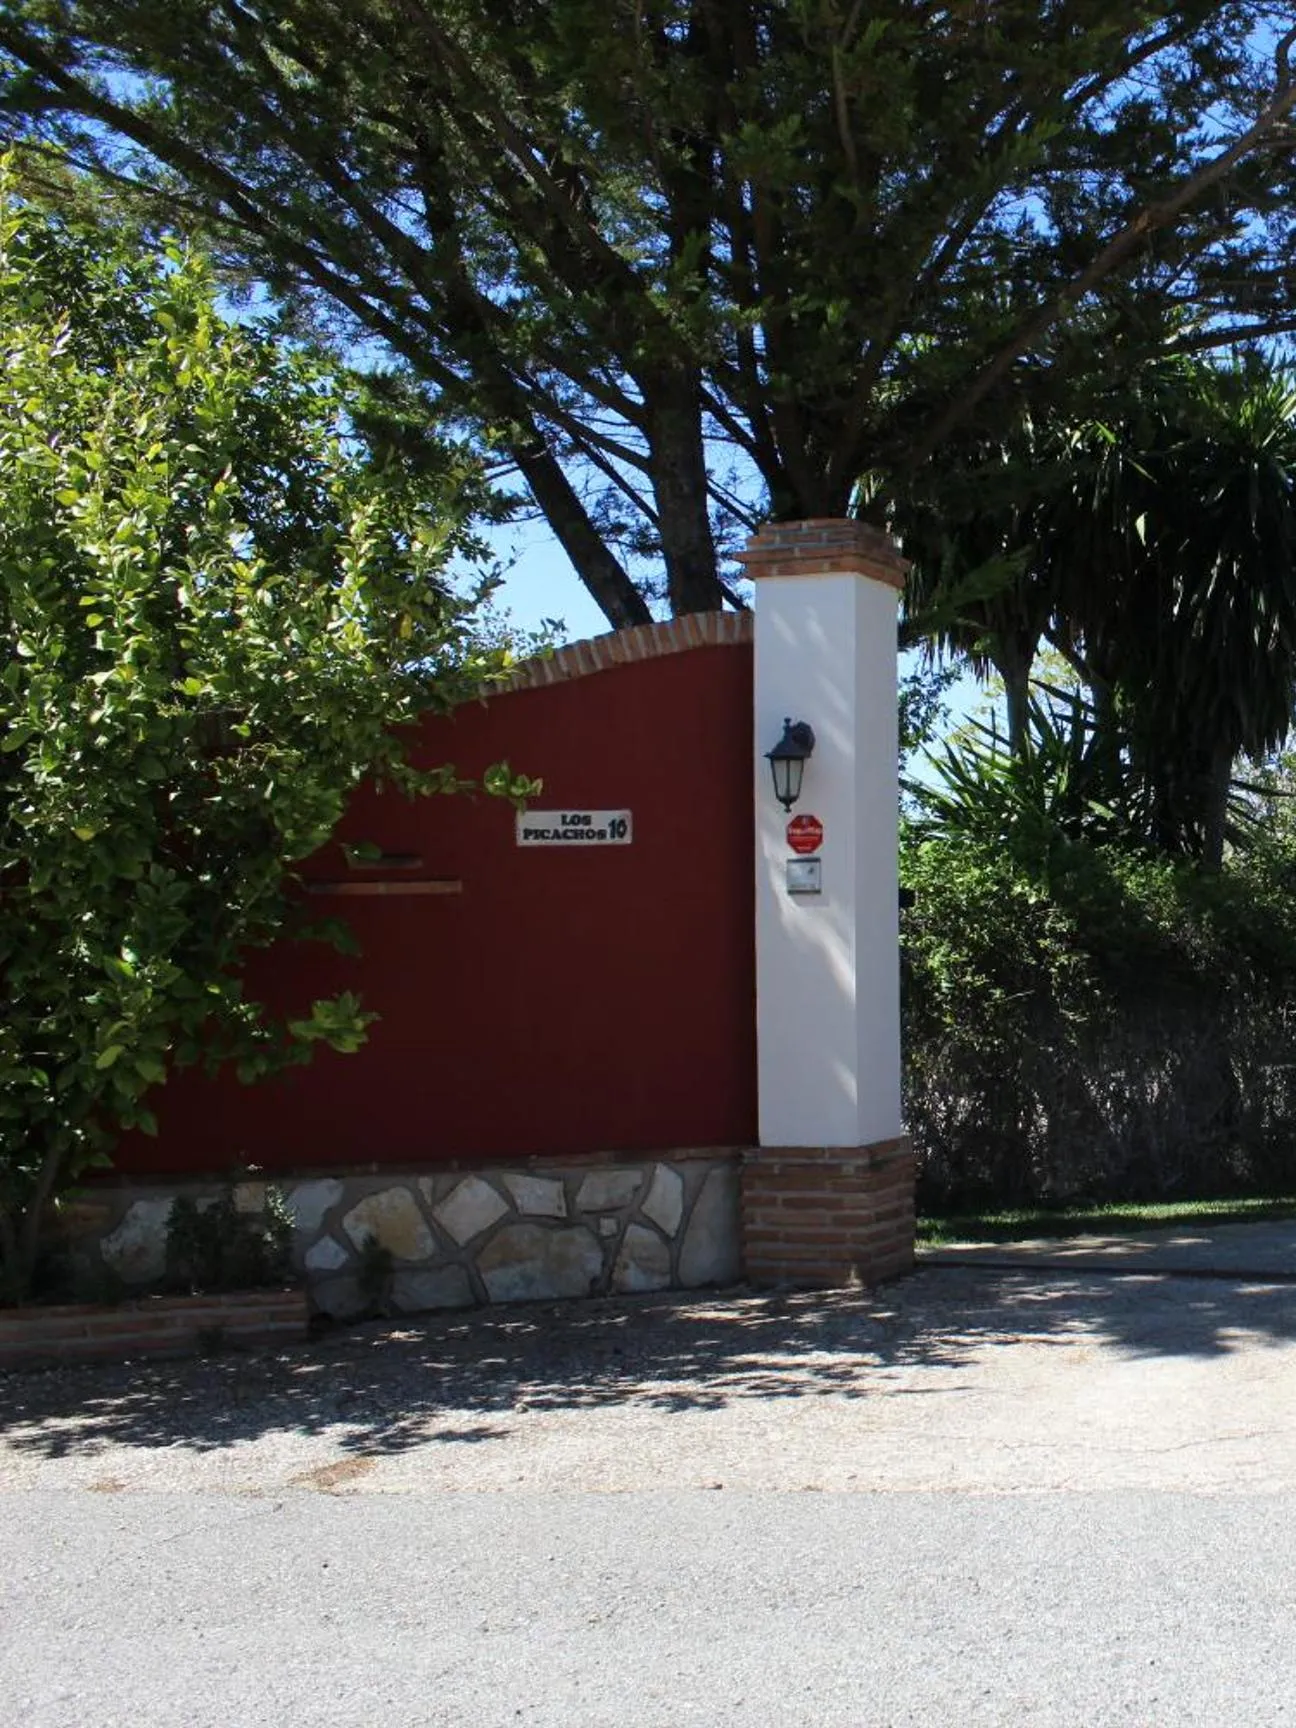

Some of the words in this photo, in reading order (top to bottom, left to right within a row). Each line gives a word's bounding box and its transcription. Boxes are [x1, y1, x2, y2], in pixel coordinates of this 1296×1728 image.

[561, 814, 592, 826] LOS
[523, 828, 607, 840] PICACHOS
[608, 819, 627, 839] 10
